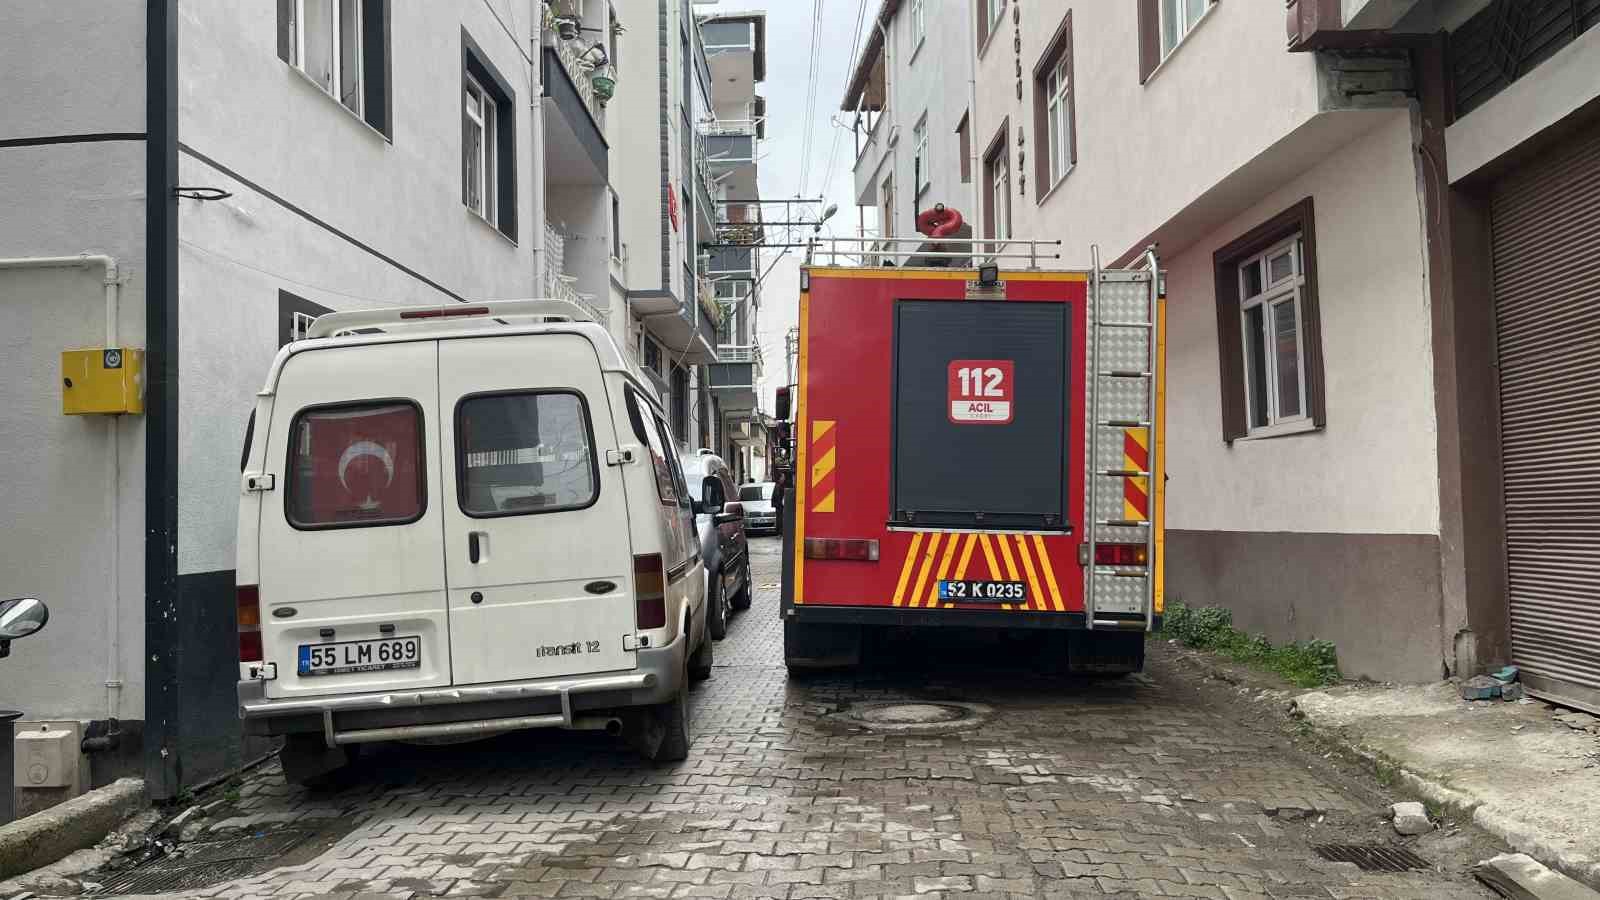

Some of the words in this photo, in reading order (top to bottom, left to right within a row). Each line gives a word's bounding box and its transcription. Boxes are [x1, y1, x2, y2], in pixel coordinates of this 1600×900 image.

[958, 367, 1004, 397] 112
[947, 582, 967, 598] 52
[972, 582, 983, 598] K
[986, 583, 1023, 598] 0235
[311, 648, 336, 667] 55
[345, 644, 372, 665] LM
[379, 640, 416, 662] 689
[586, 640, 600, 653] 12
